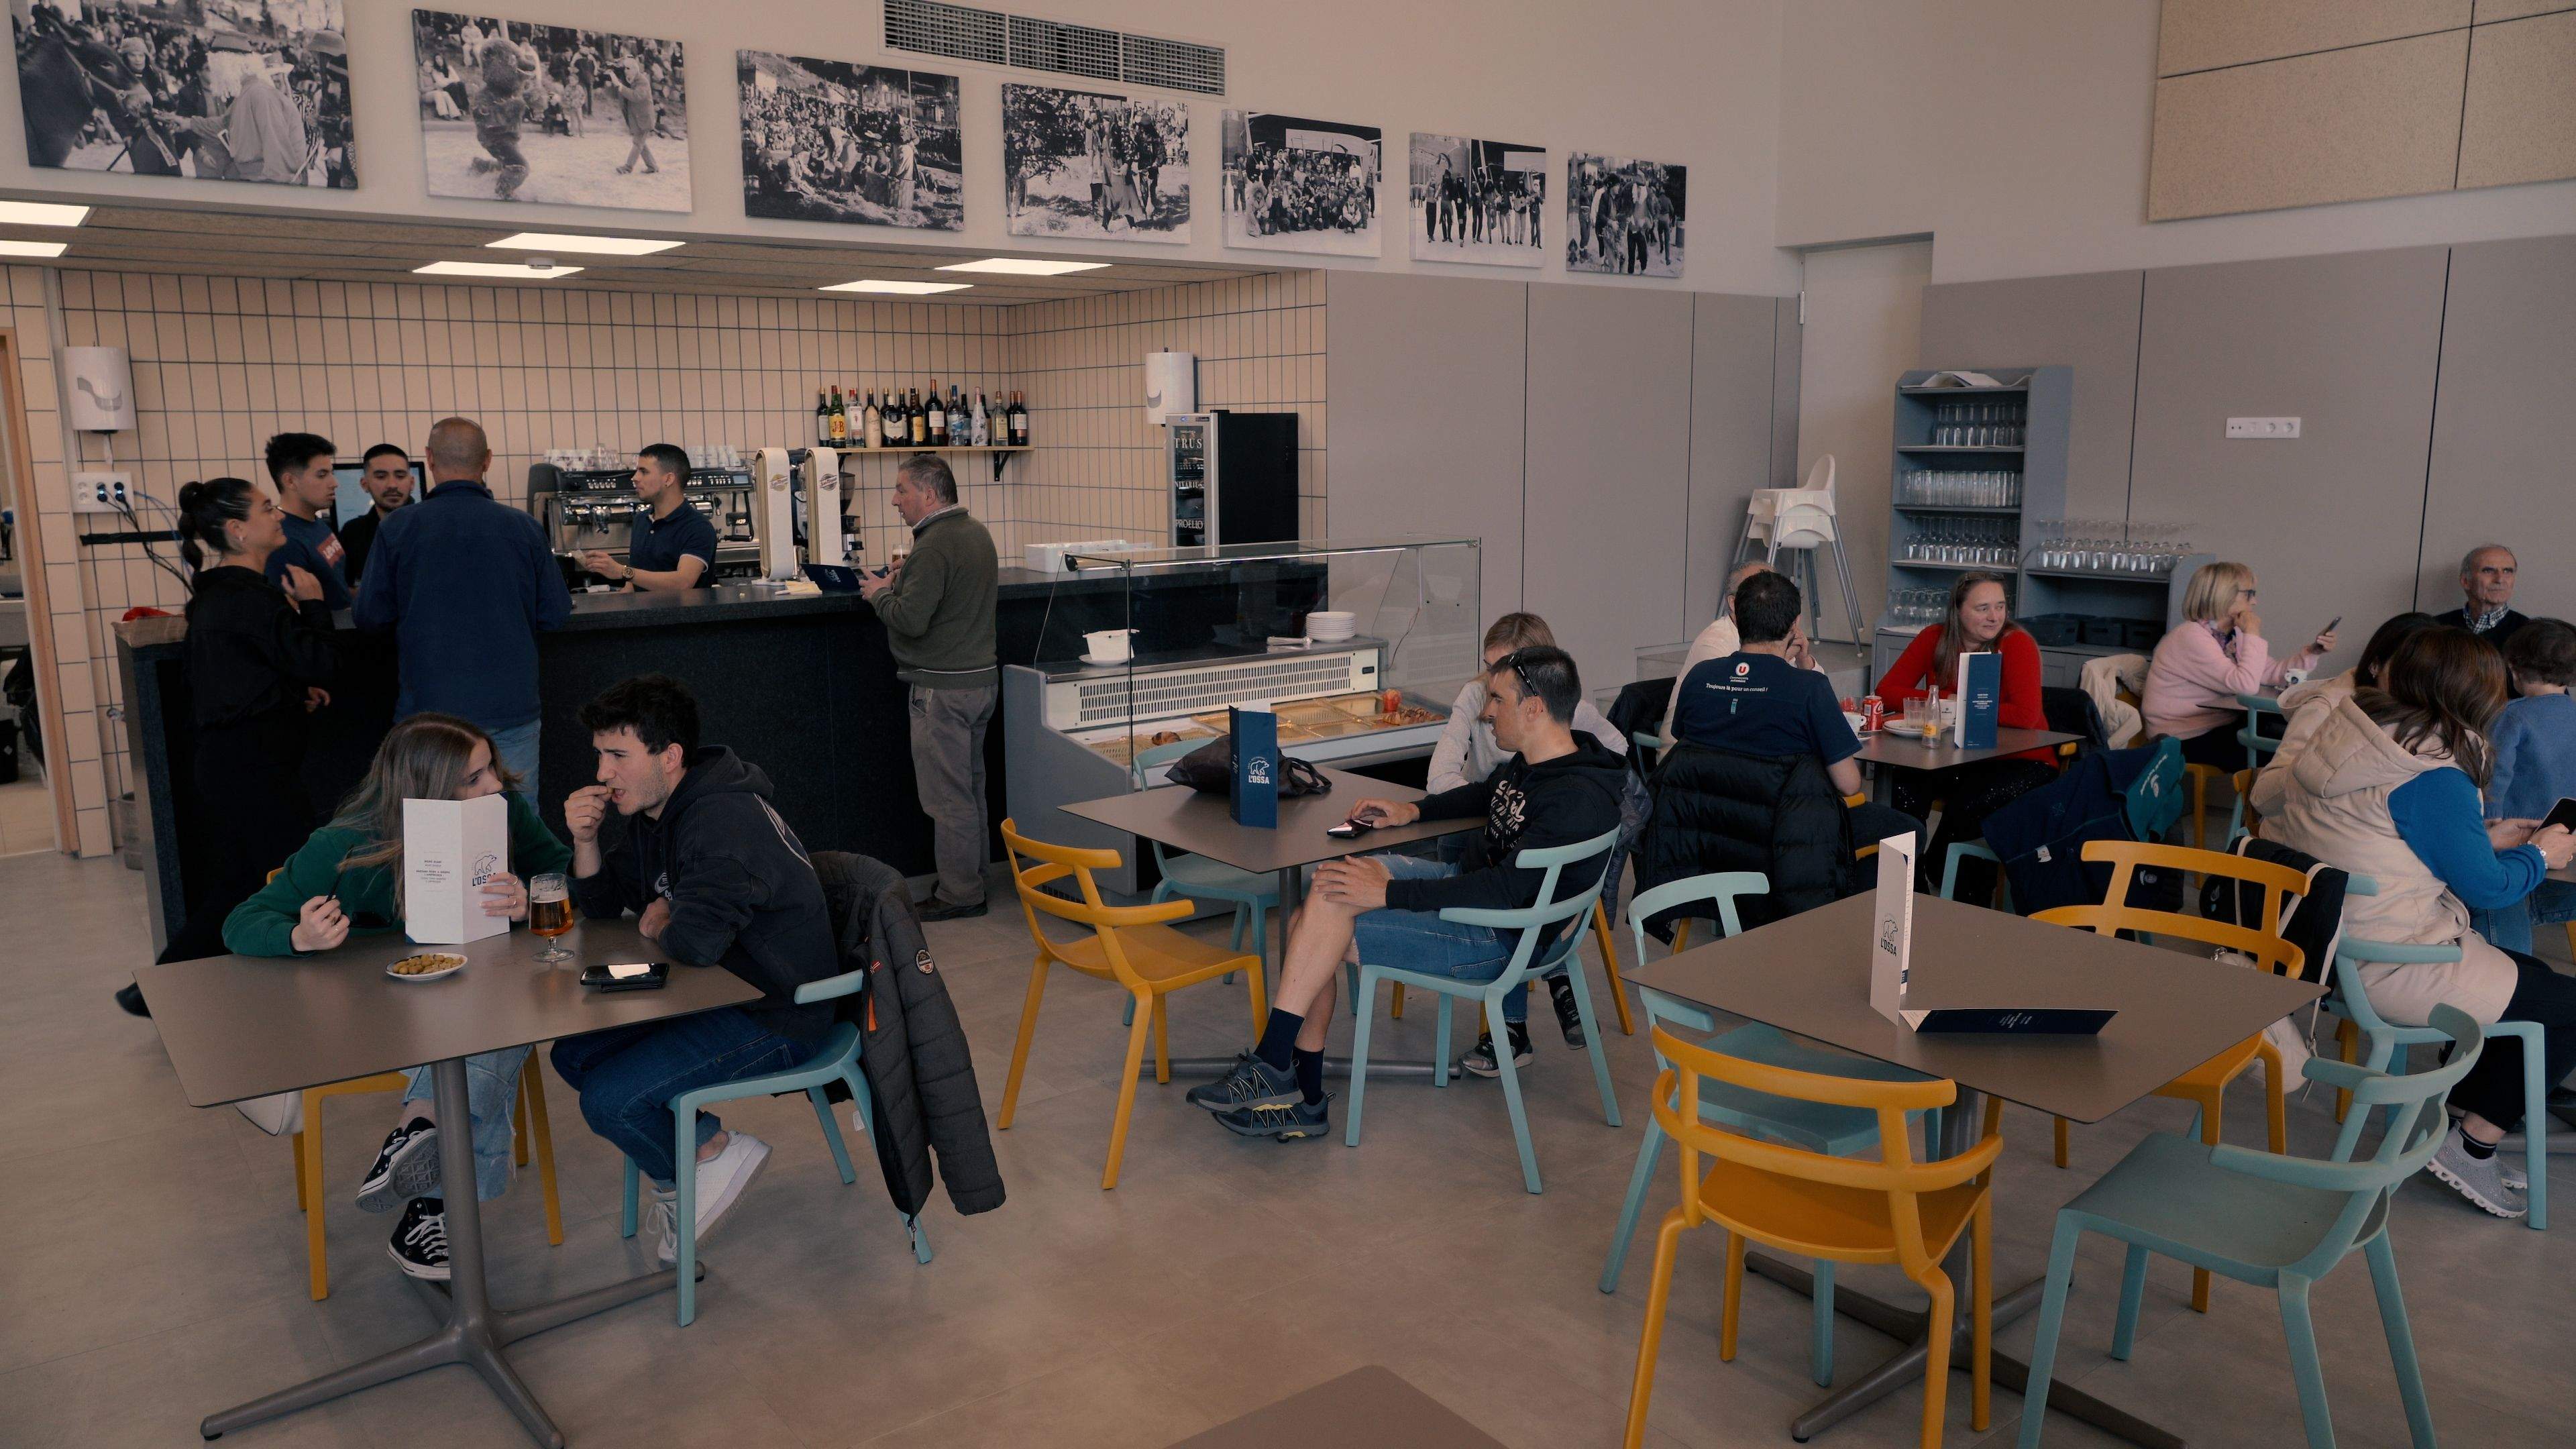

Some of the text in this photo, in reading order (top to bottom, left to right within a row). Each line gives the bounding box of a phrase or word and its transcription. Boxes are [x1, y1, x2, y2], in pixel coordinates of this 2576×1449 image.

[1175, 438, 1202, 449] TRUS
[1248, 775, 1270, 785] L'OSSA
[472, 873, 496, 887] L'OS
[1880, 938, 1897, 957] L'OSSA
